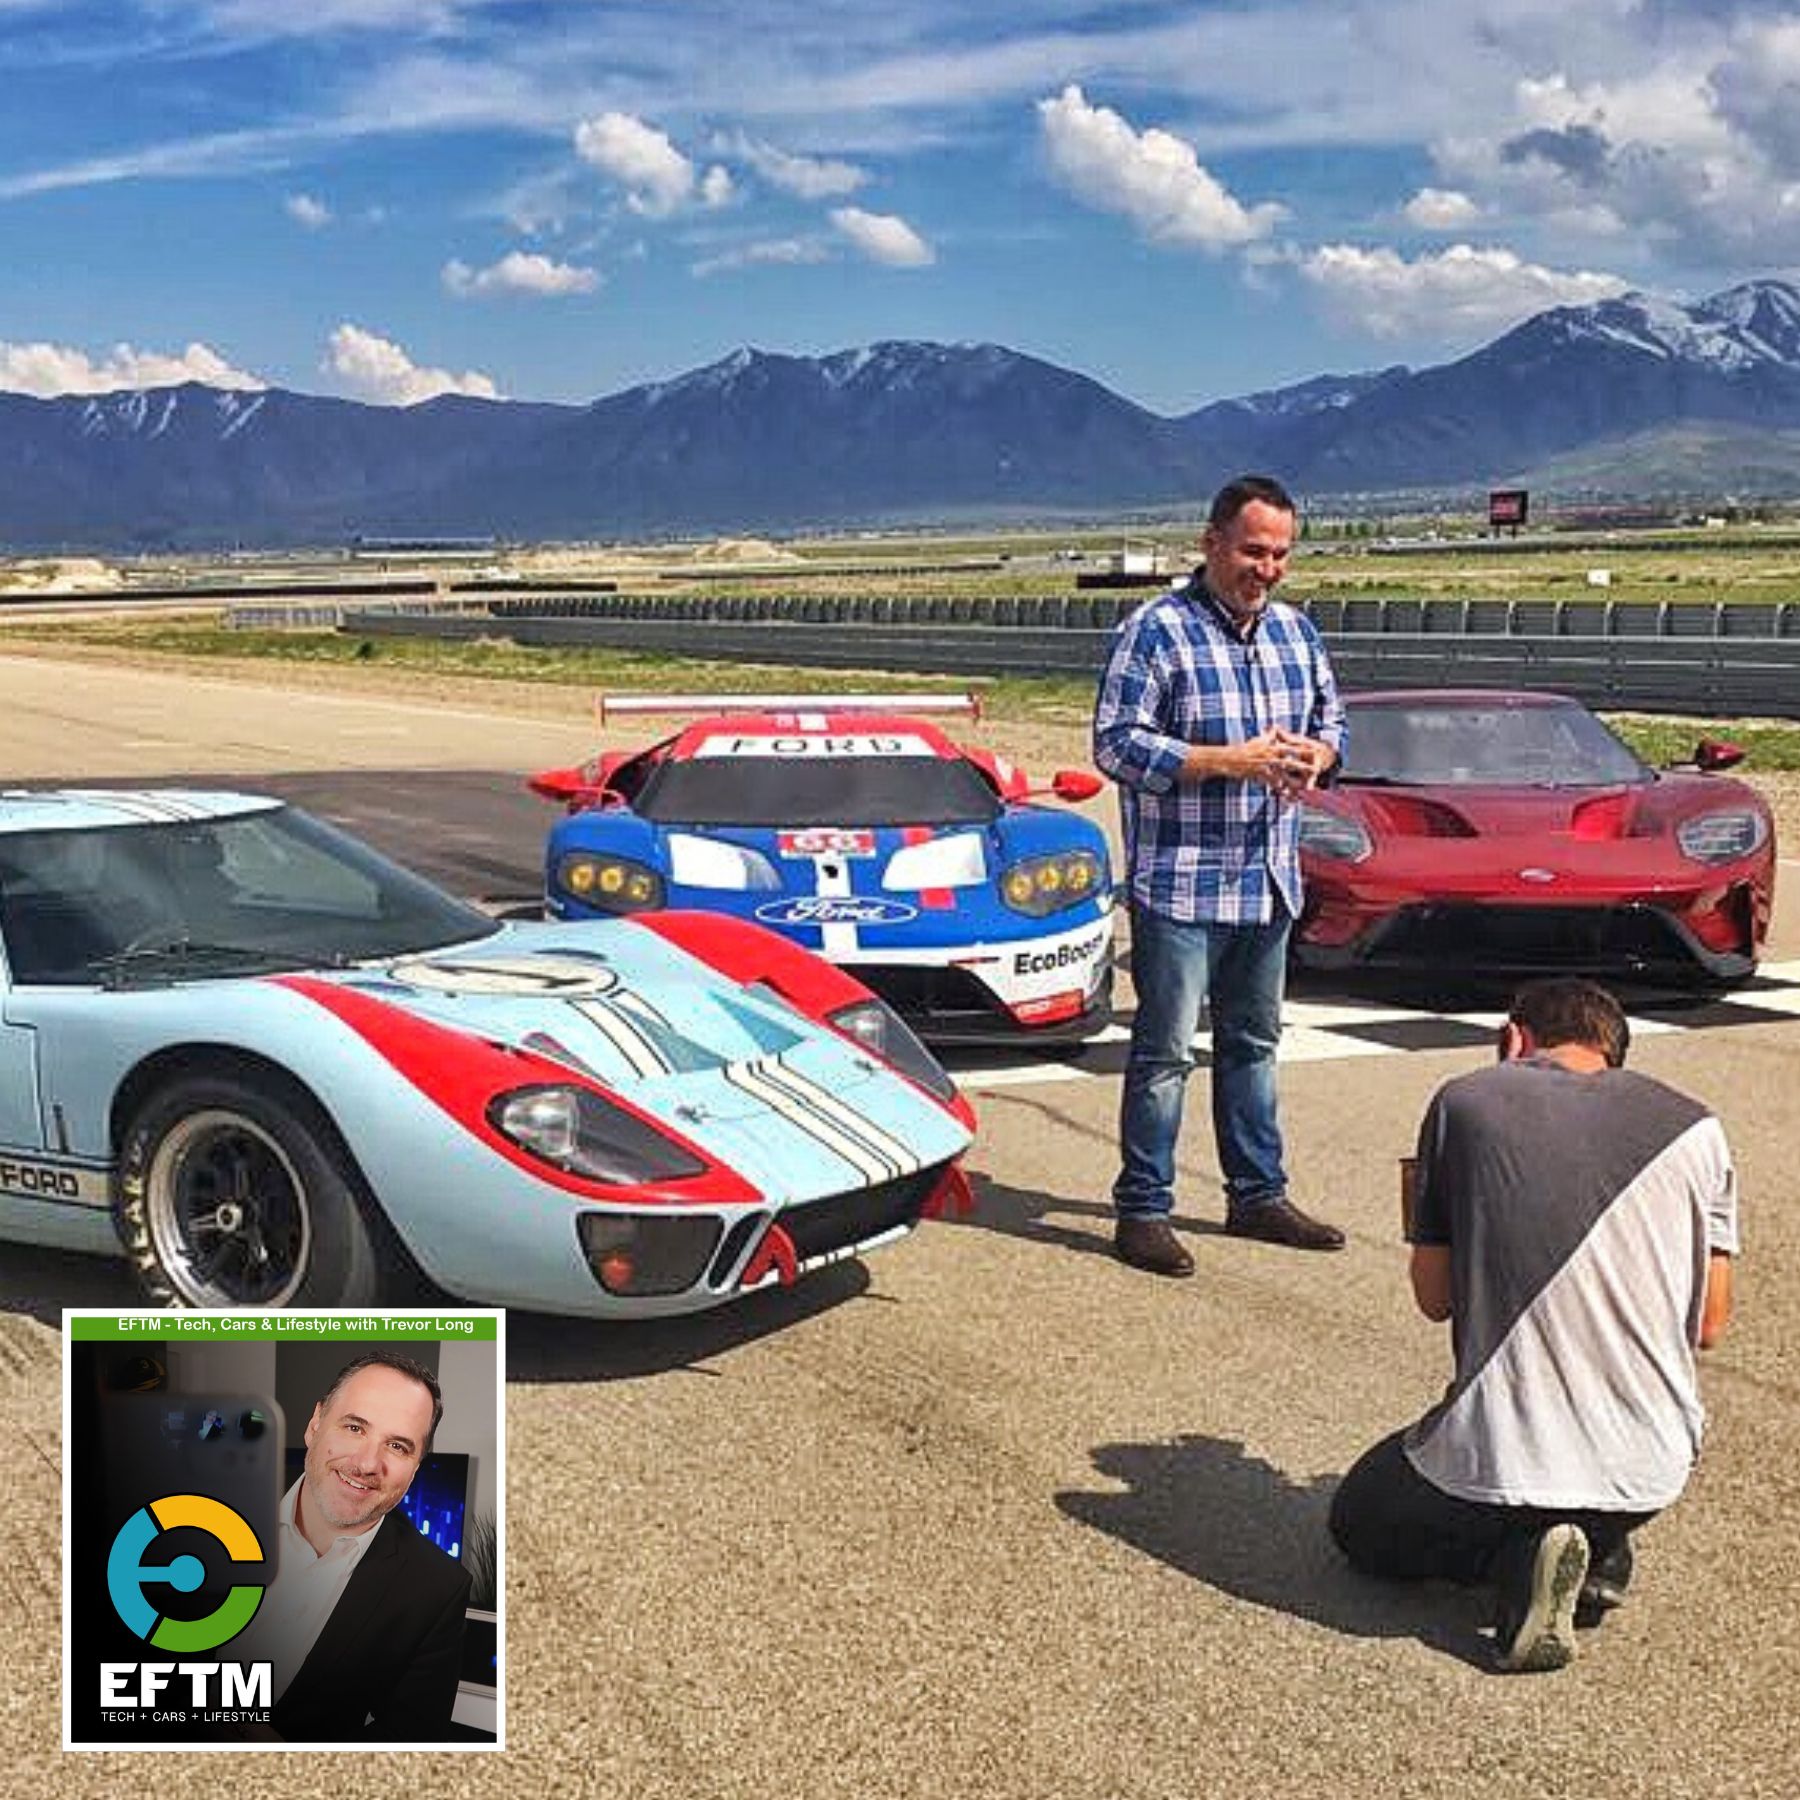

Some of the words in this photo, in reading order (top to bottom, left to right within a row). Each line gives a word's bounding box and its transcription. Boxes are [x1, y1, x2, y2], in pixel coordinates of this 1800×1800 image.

[732, 738, 903, 754] FORD
[786, 896, 889, 921] Ford
[0, 1162, 79, 1197] FORD
